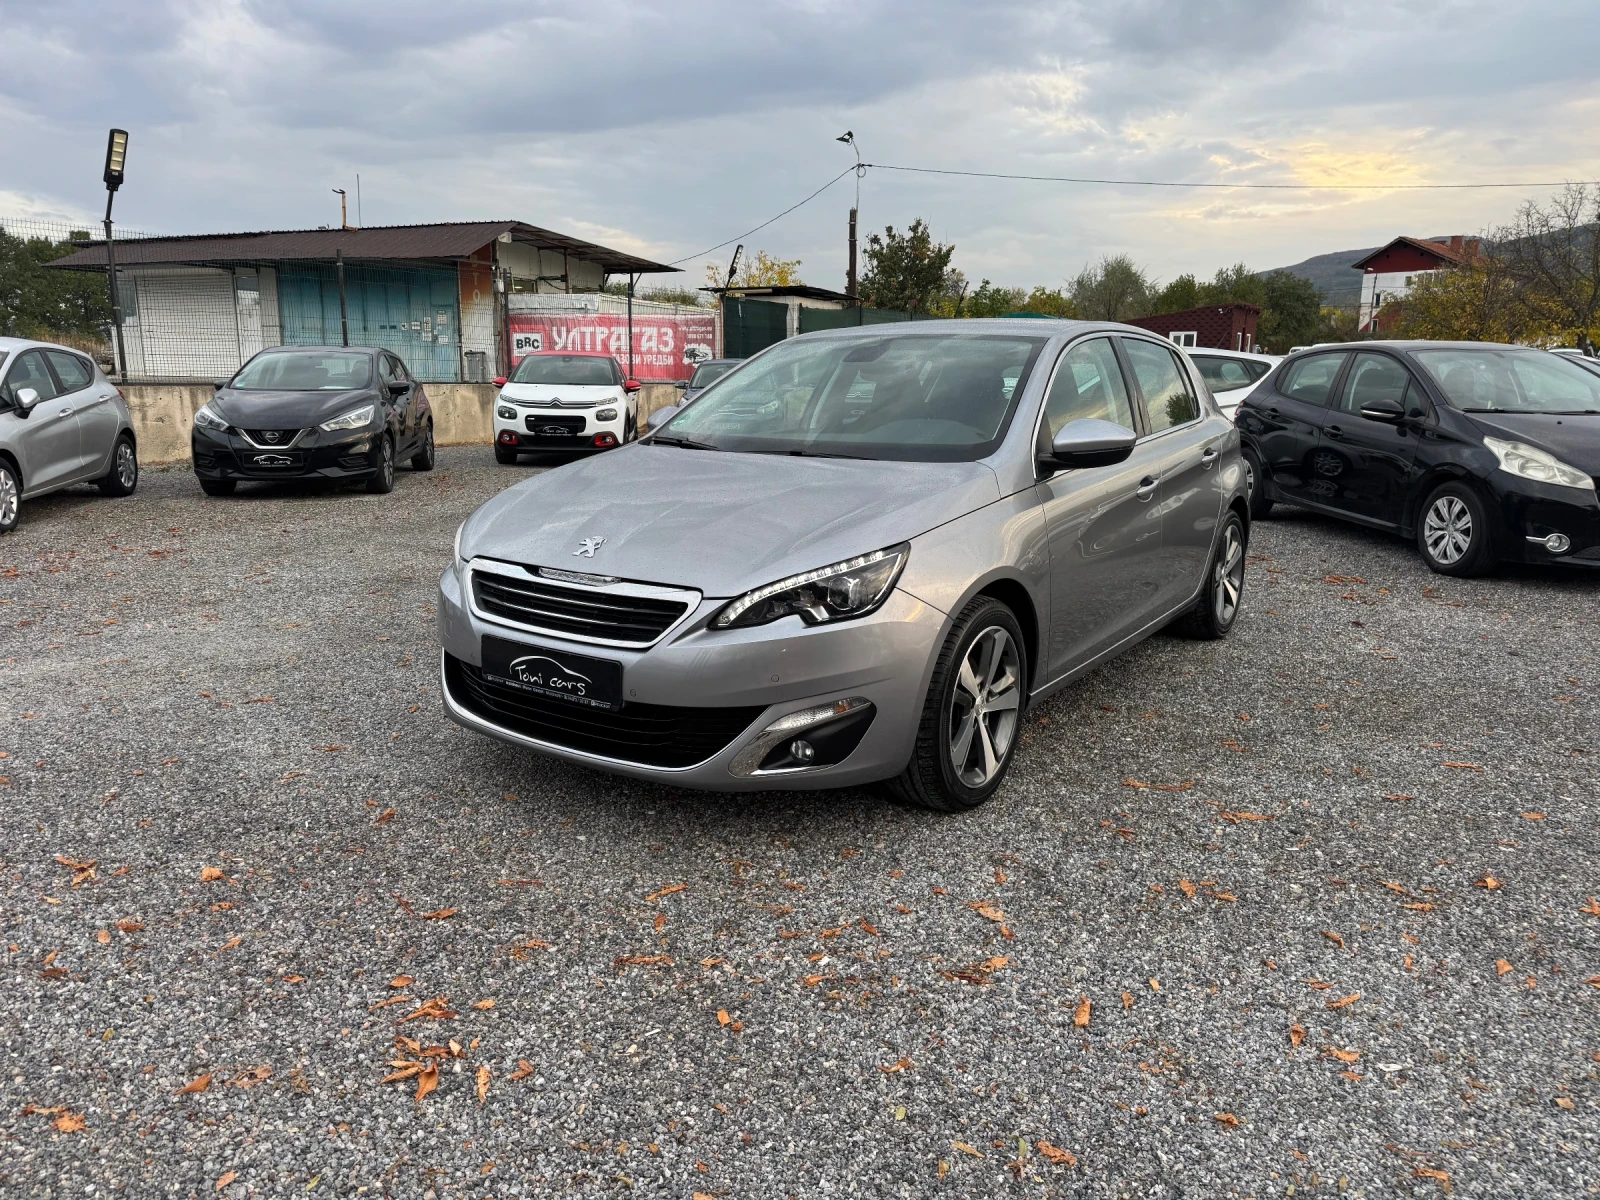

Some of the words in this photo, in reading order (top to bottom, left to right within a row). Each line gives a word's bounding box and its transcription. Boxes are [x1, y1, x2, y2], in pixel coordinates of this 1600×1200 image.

[516, 336, 540, 350] BRC
[551, 326, 675, 352] УЛТРАГАЗ
[643, 354, 674, 366] УРЕДБИ
[514, 665, 543, 685] Toni
[549, 677, 586, 696] cars
